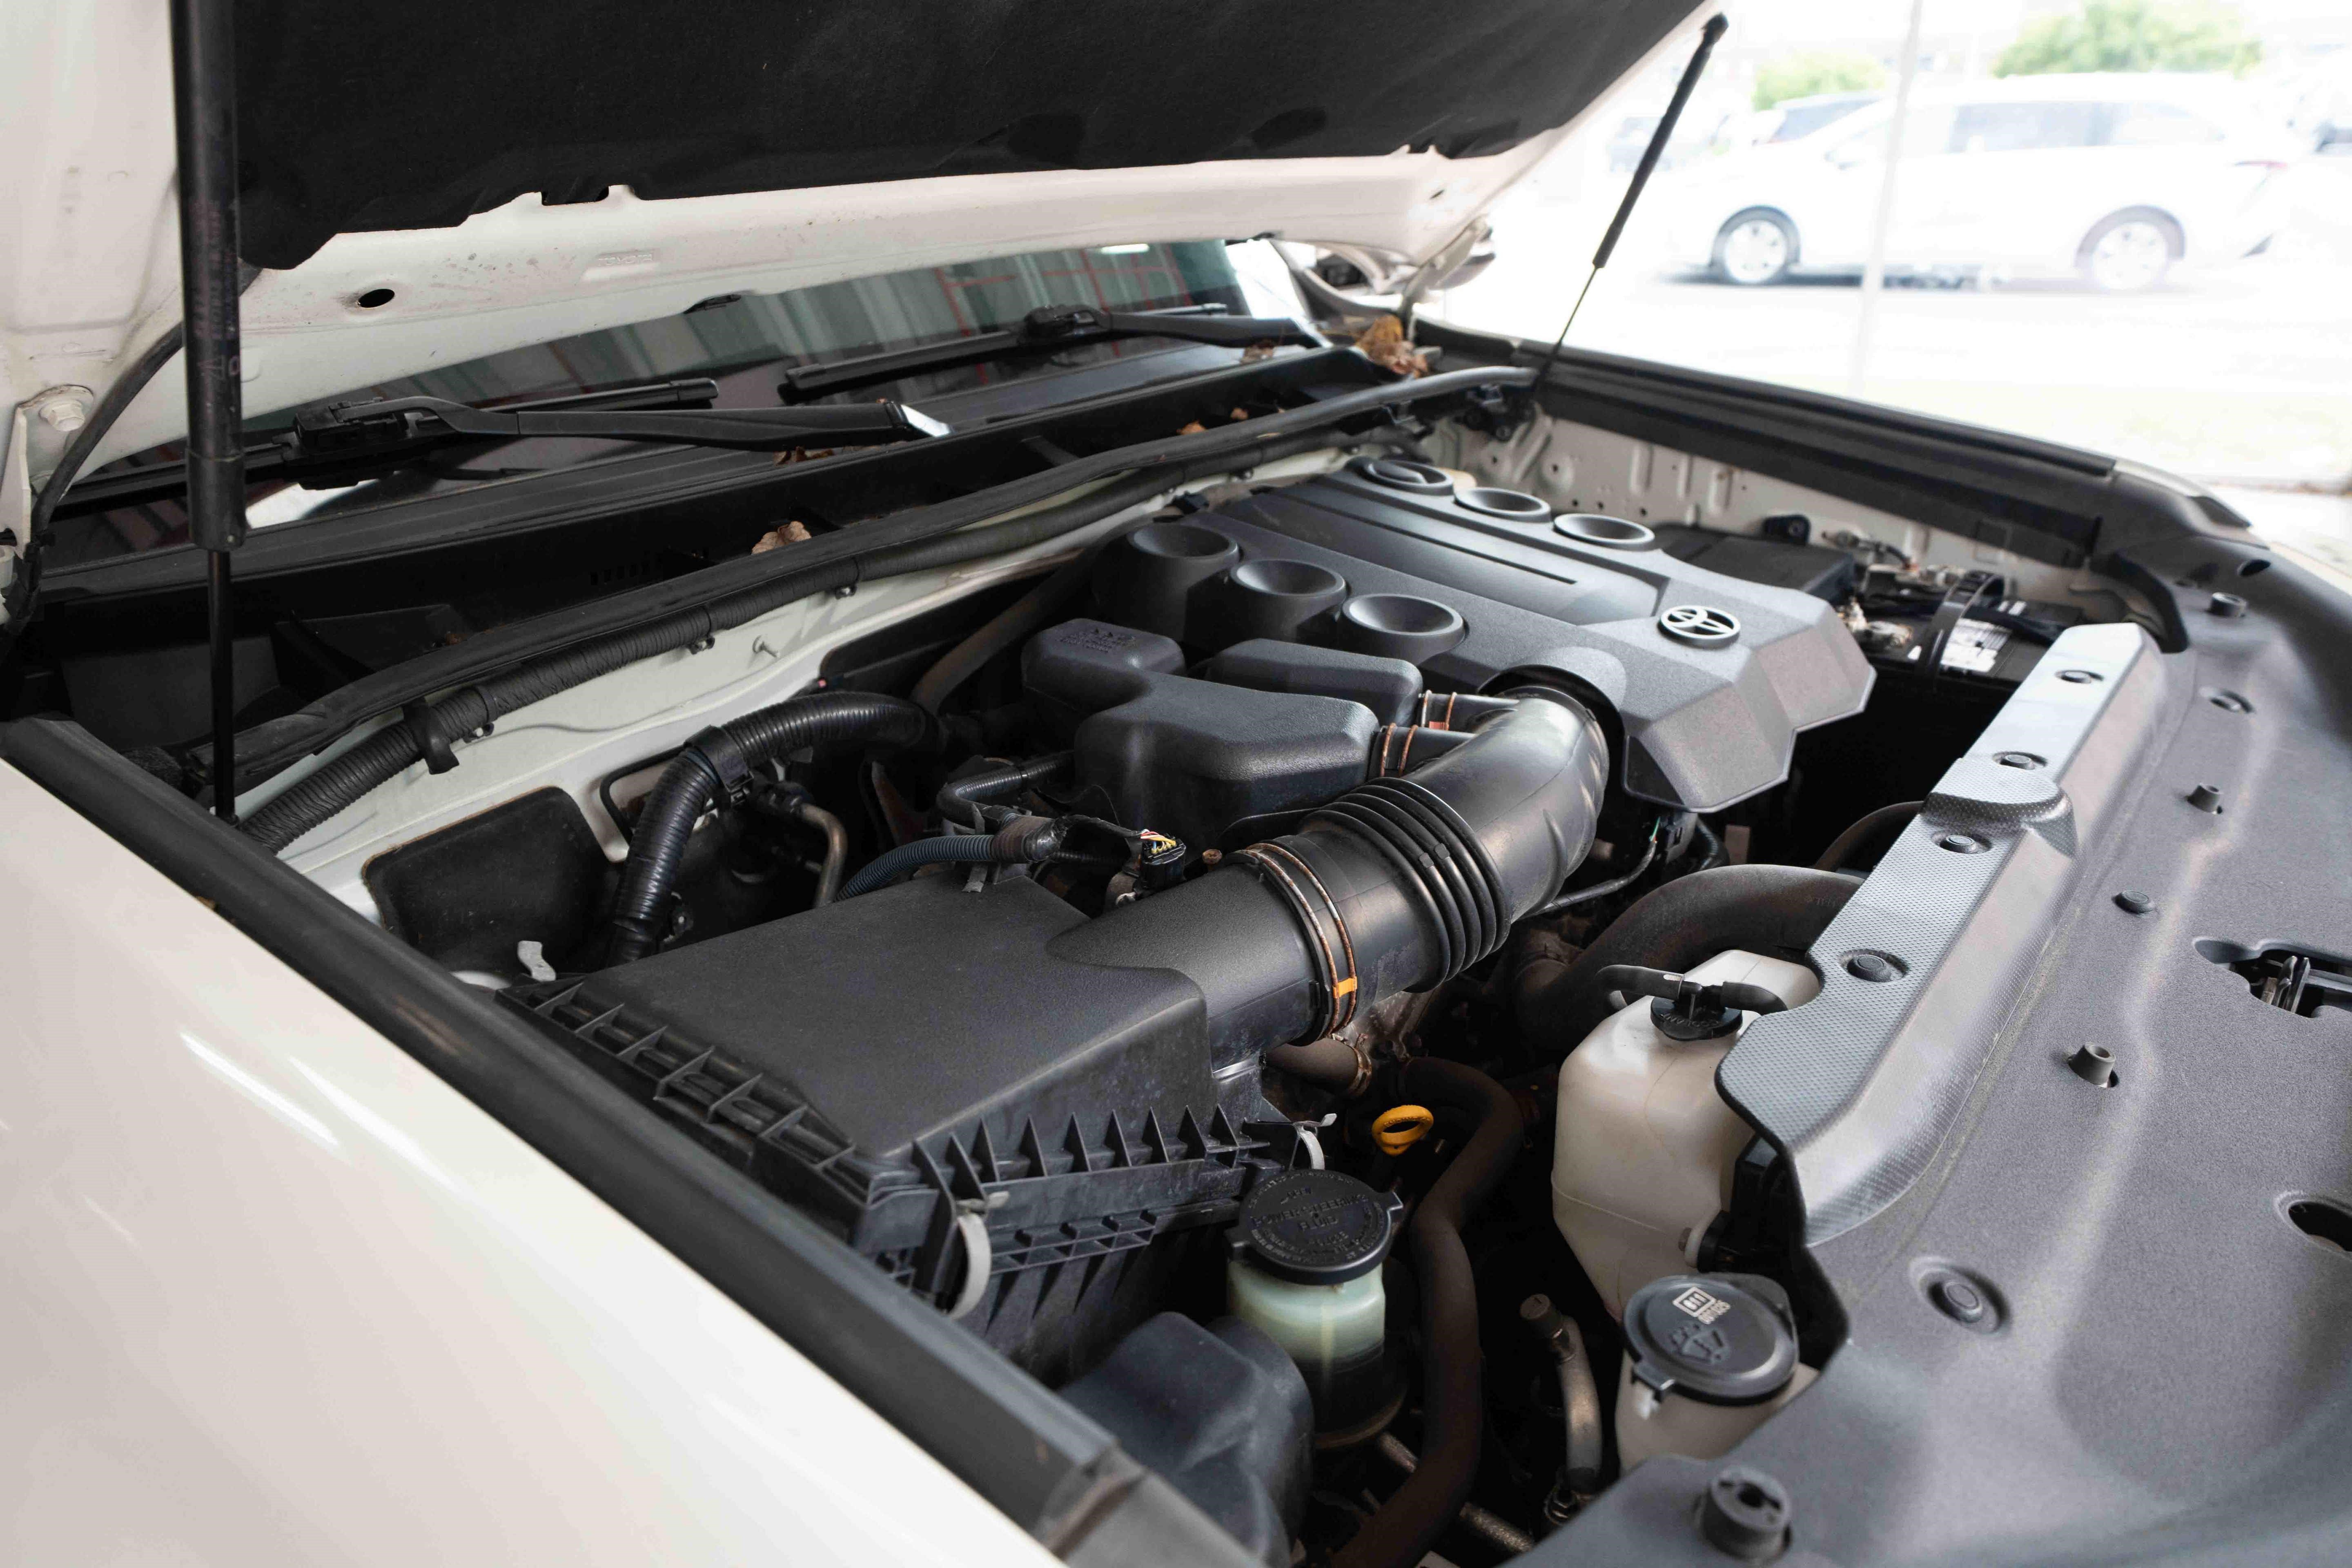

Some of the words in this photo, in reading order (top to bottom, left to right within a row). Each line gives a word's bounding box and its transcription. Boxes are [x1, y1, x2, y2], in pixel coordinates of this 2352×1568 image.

[597, 253, 654, 267] TOYOTA
[1250, 1209, 1301, 1227] POWER
[1301, 1194, 1369, 1215] STEERING
[1298, 1216, 1339, 1231] FLUID
